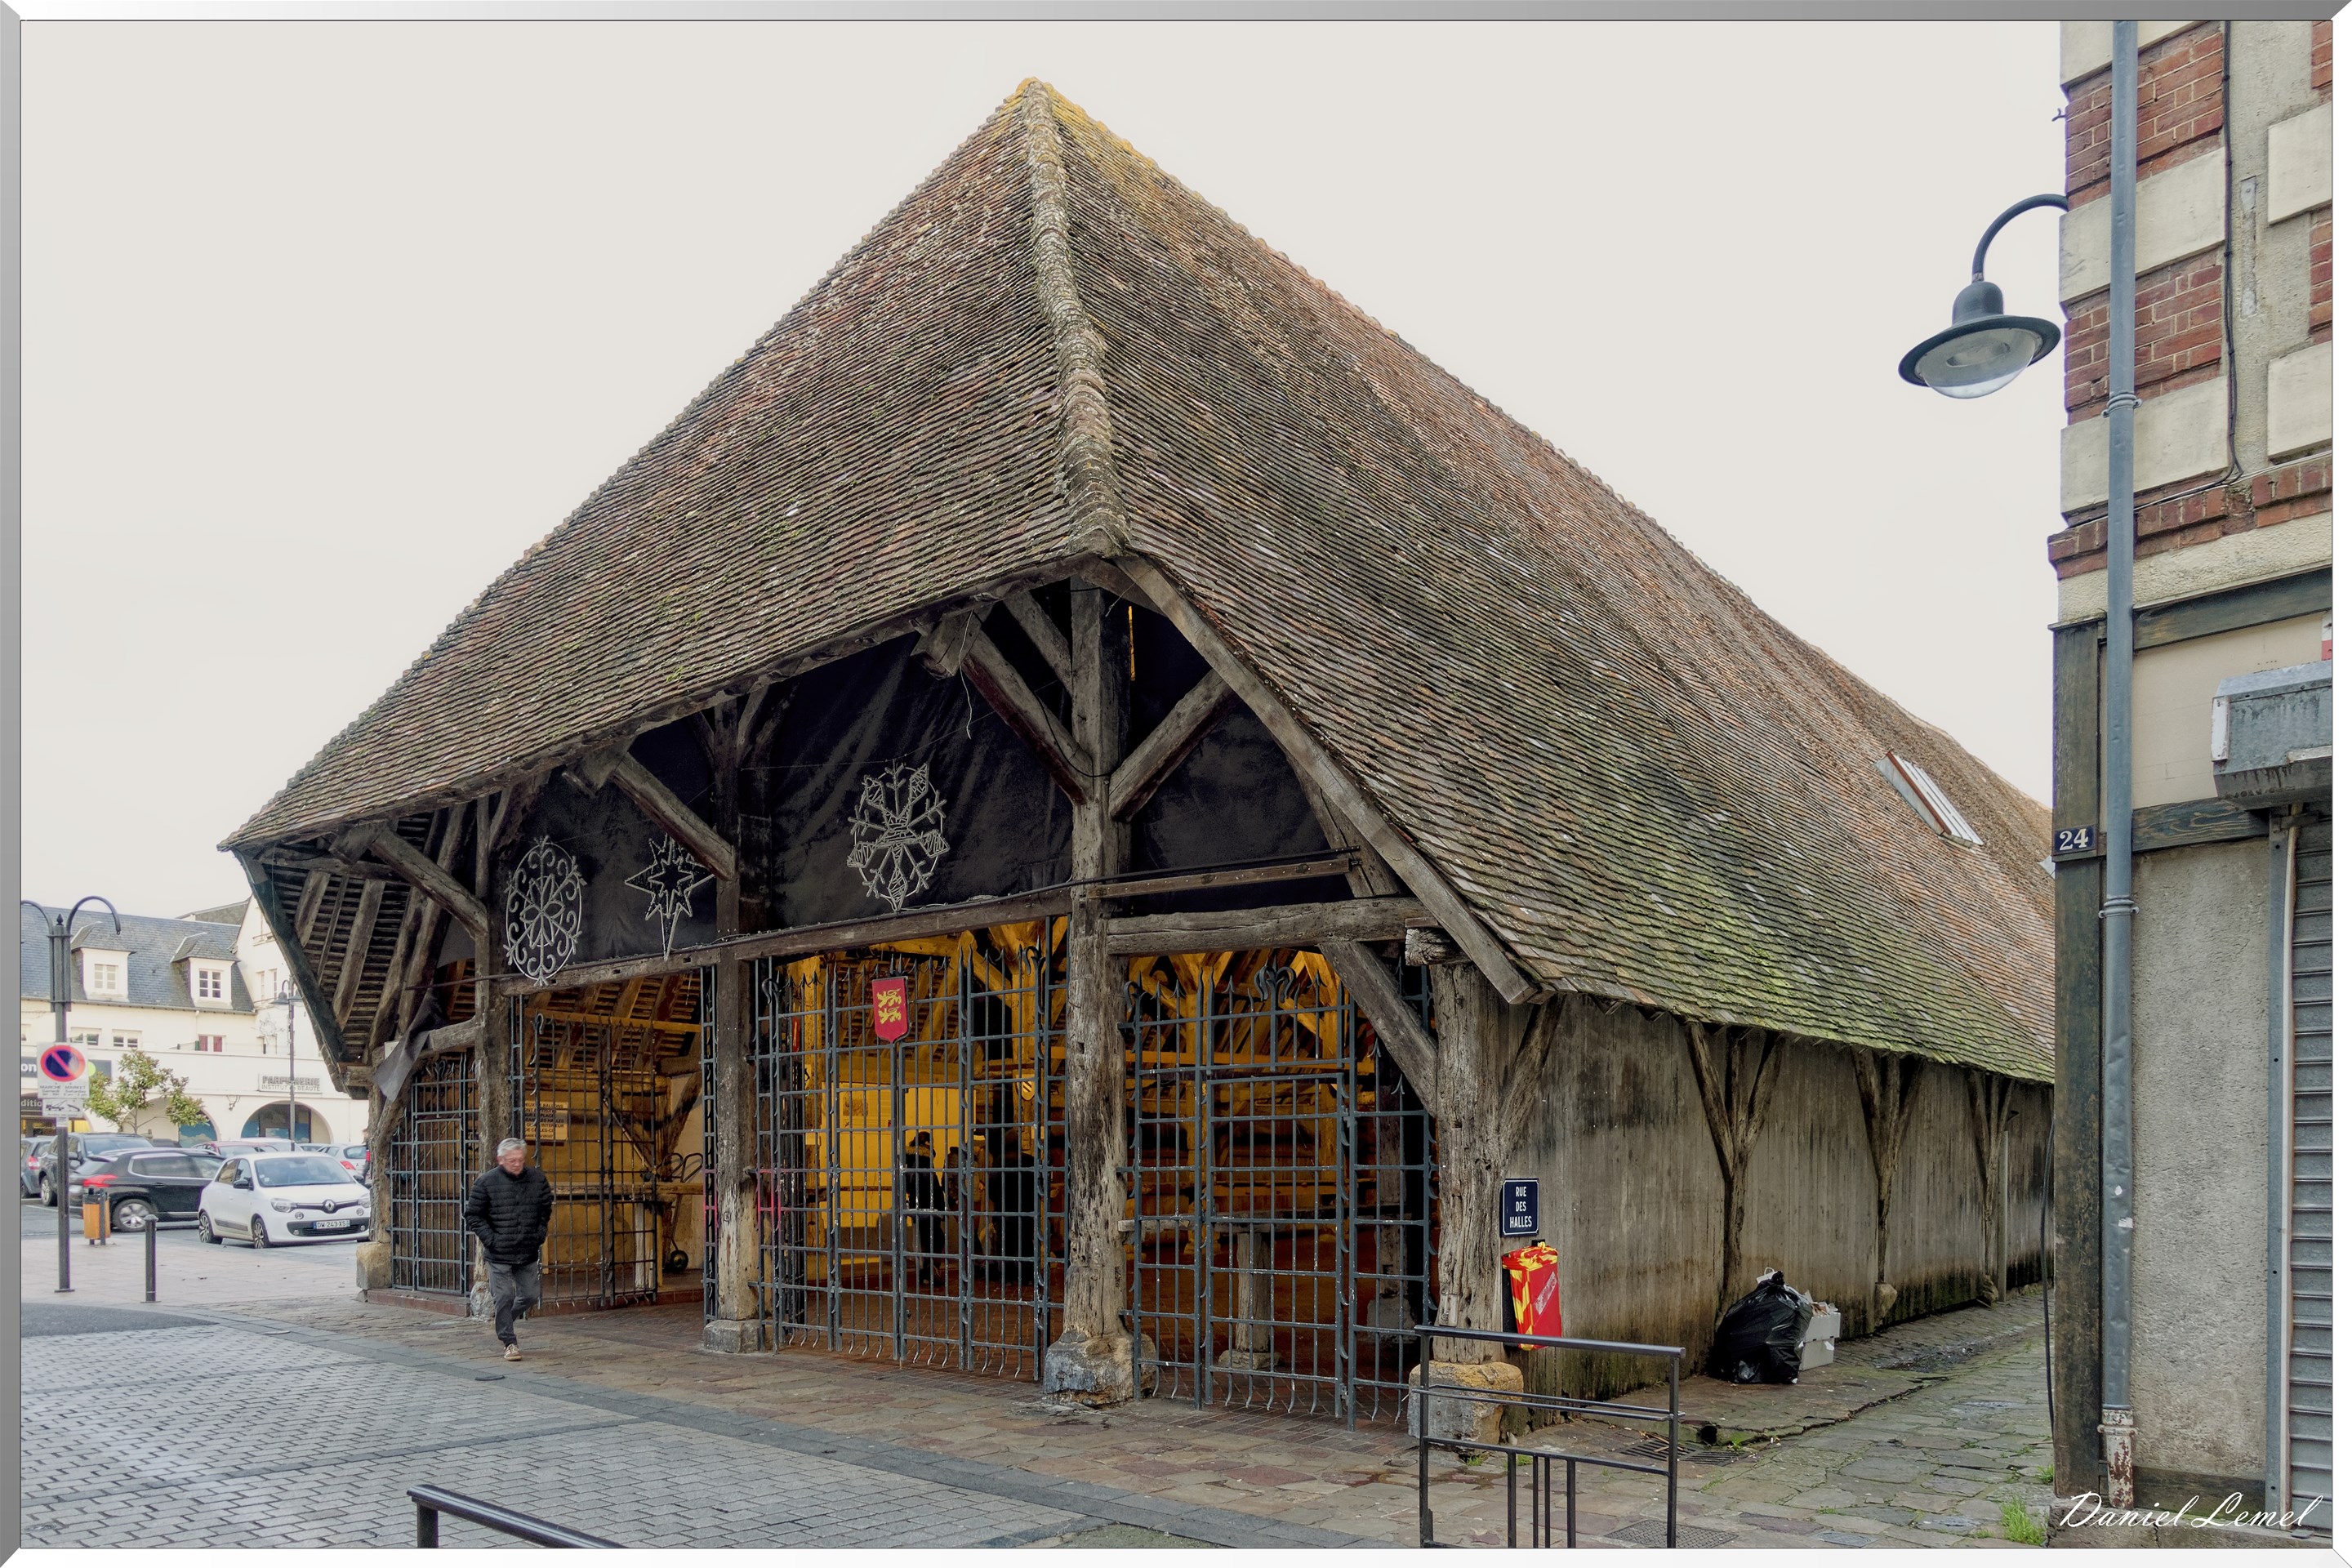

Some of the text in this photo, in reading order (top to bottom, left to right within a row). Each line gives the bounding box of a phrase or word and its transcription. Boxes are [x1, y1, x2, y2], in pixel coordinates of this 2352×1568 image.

[2059, 828, 2089, 851] 24
[1515, 1186, 1527, 1197] RUE
[1515, 1200, 1527, 1212] DES
[1509, 1215, 1533, 1228] HALLES
